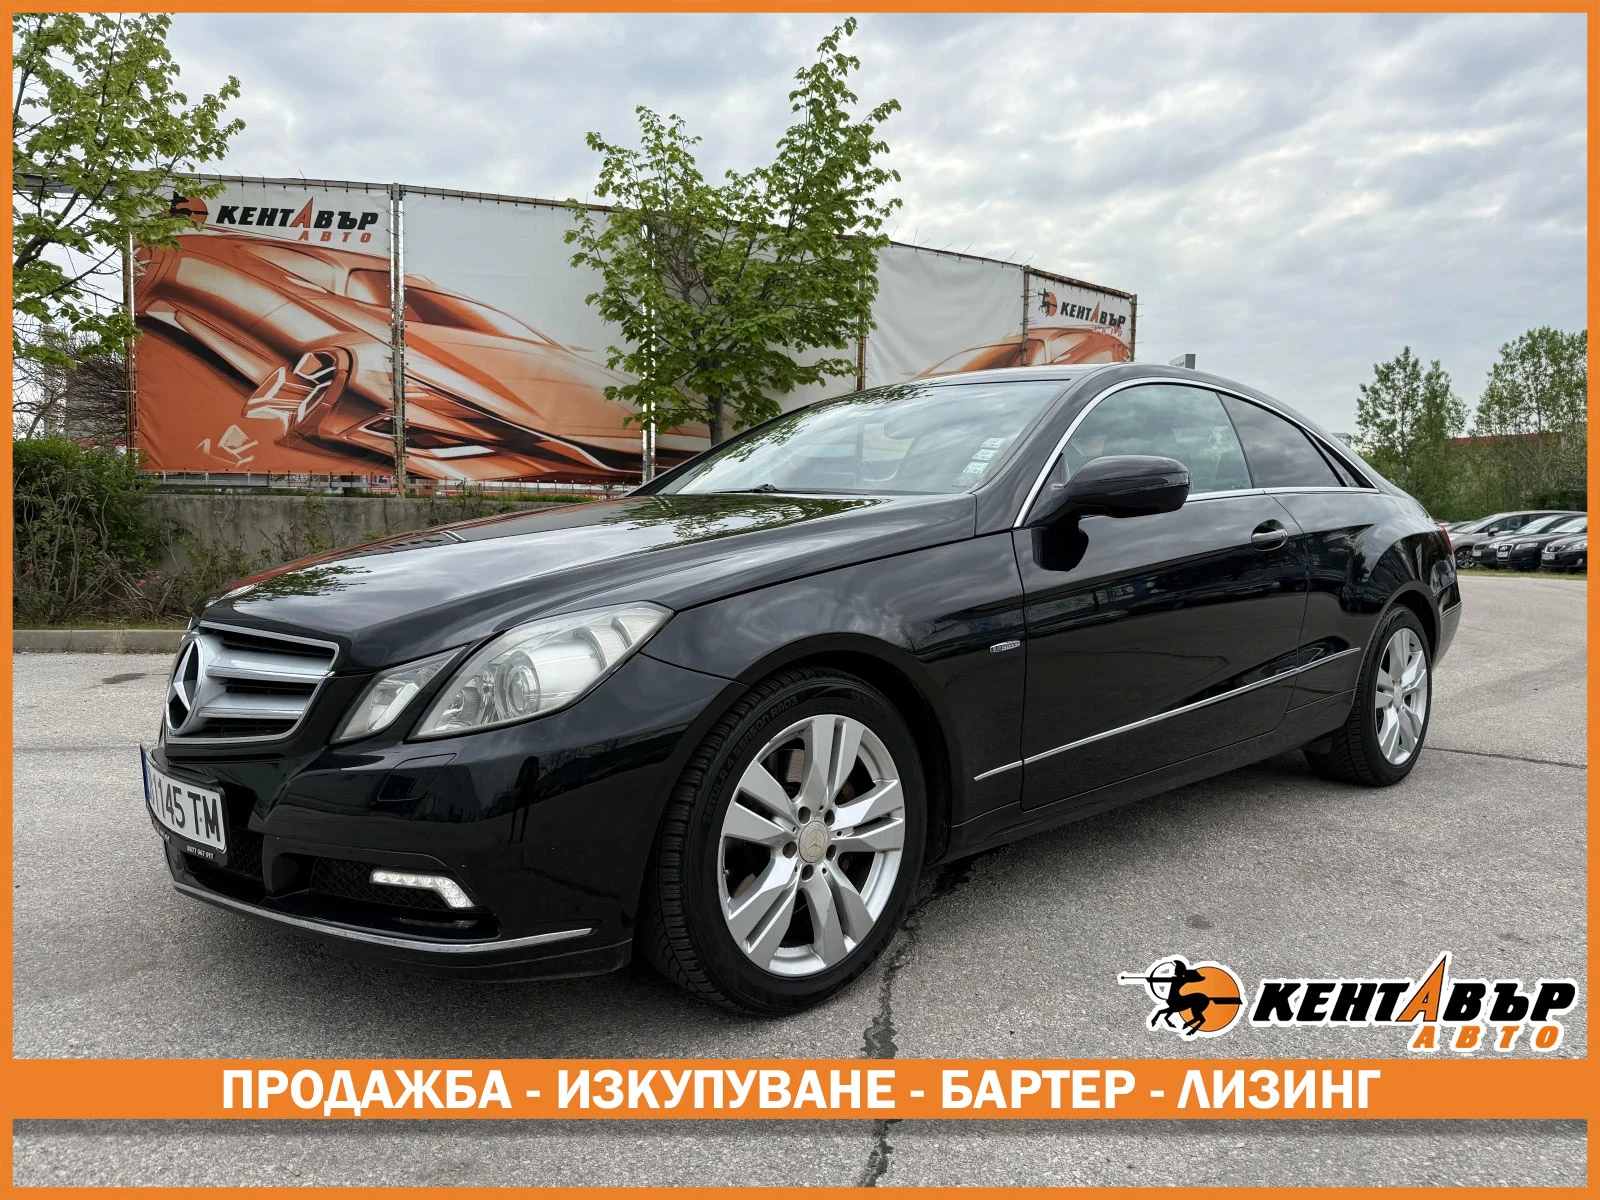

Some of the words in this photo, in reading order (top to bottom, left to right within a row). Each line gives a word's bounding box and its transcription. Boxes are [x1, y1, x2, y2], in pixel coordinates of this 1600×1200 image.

[216, 197, 379, 231] КЕНТАВЪР
[298, 230, 372, 243] АВТО
[1060, 301, 1126, 327] КЕНТАВЪР
[188, 791, 221, 842] TM
